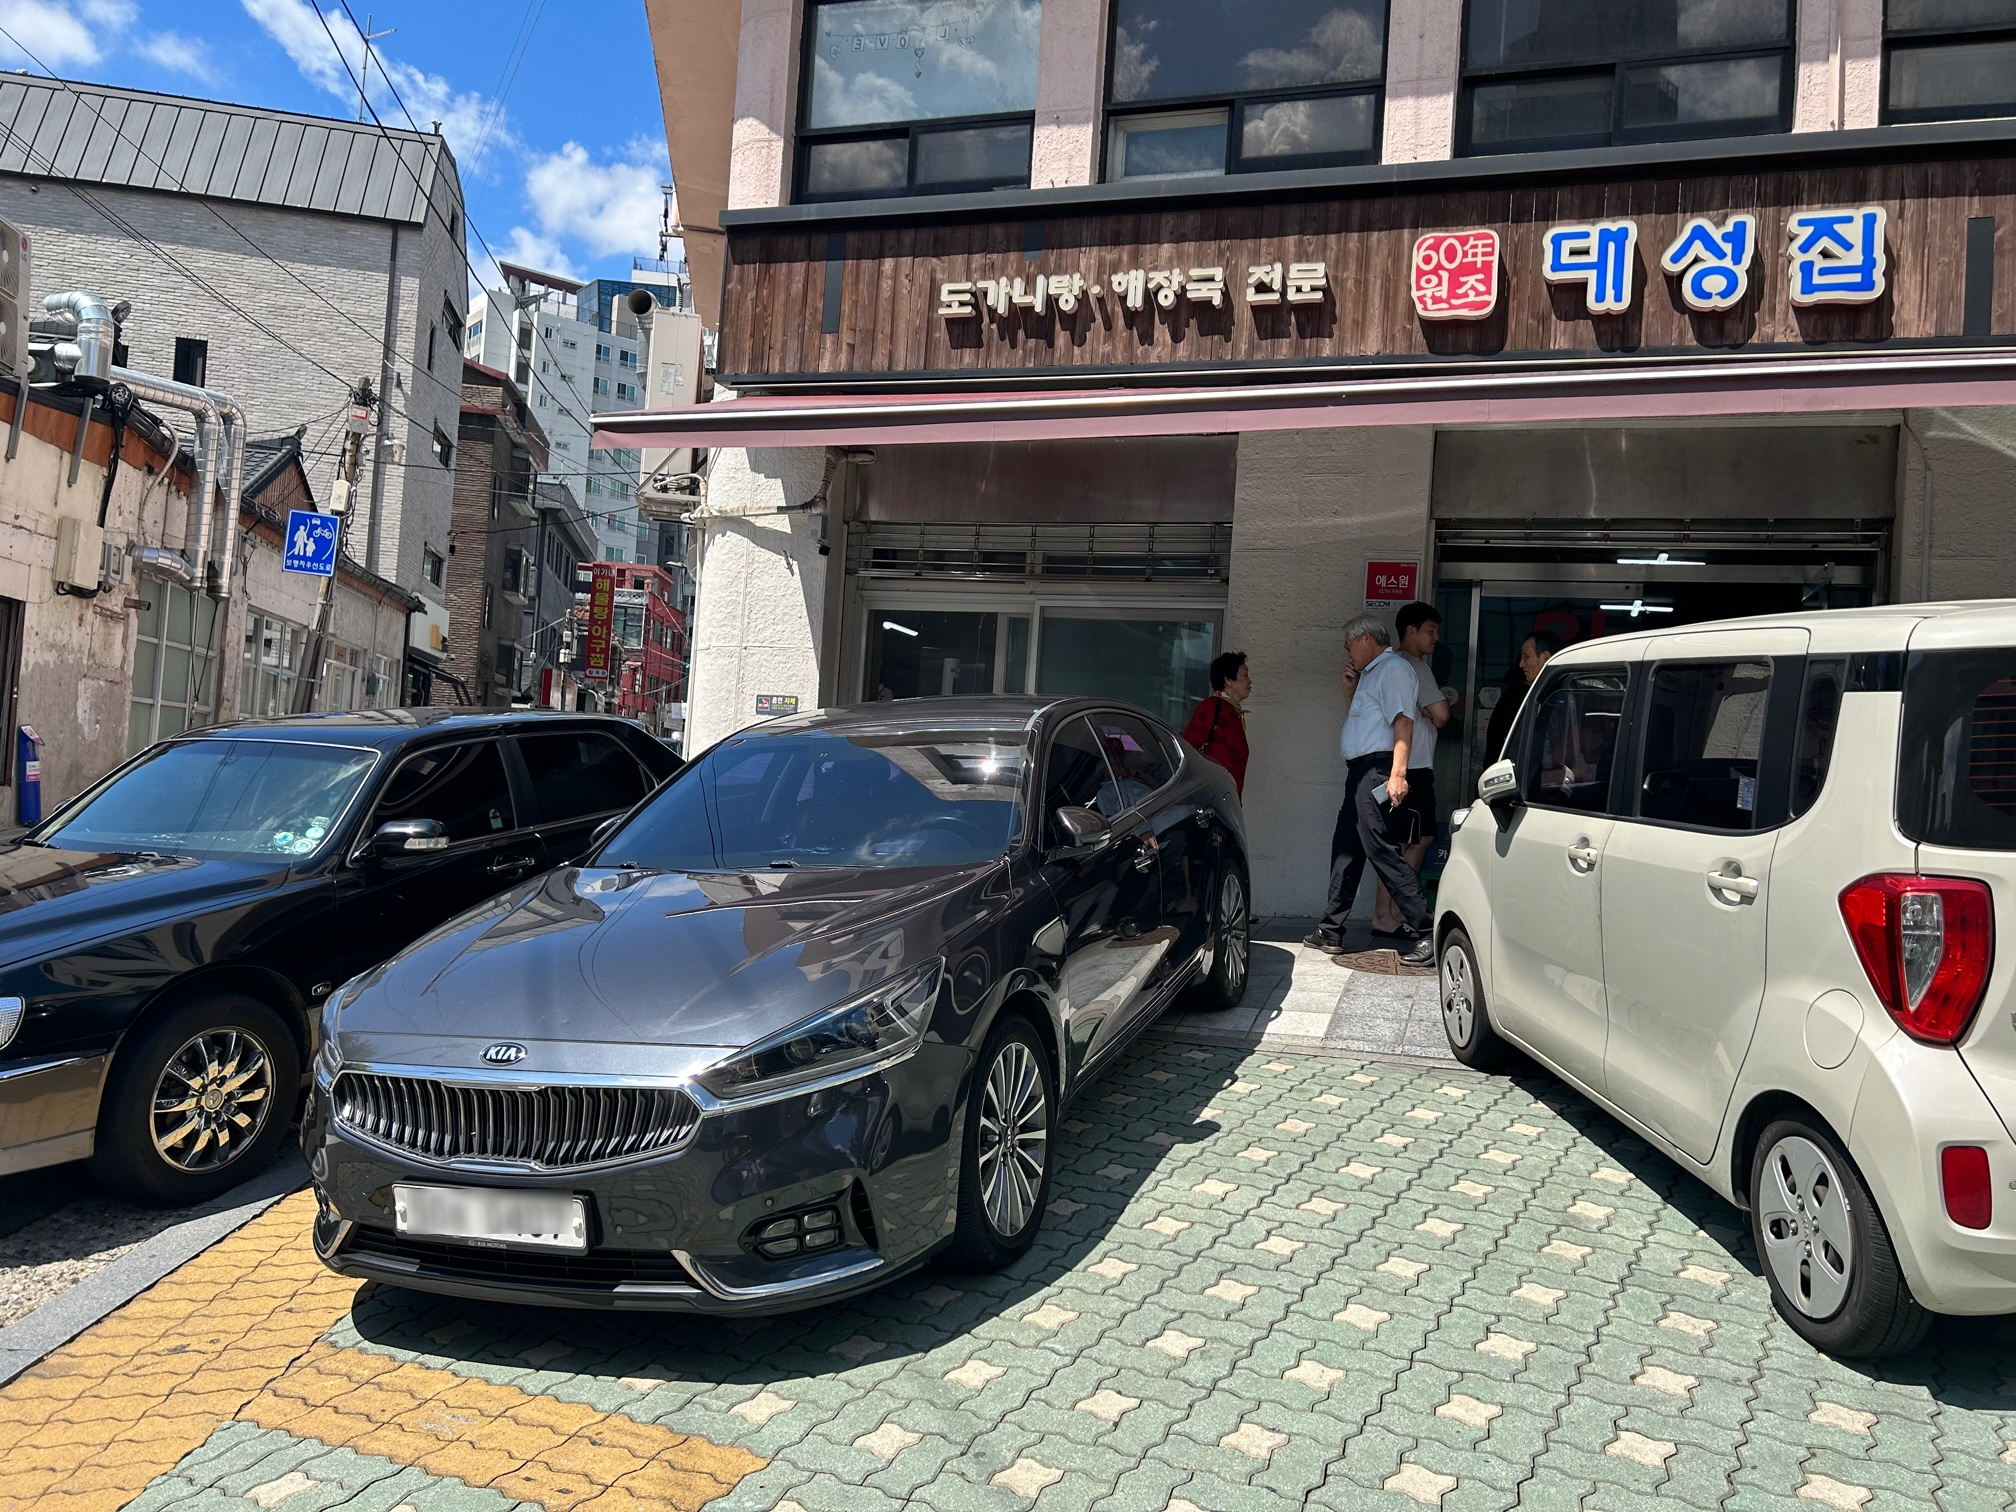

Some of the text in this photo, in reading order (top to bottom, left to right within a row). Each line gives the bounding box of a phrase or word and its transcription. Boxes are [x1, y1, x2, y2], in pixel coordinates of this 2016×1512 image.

[1415, 235, 1495, 271] 60年
[1550, 210, 1879, 305] 대성집
[1246, 261, 1328, 305] 전문
[1416, 270, 1492, 311] 원조
[286, 559, 331, 571] 보행자우선도로
[1375, 574, 1409, 588] 에스원
[486, 1046, 517, 1060] KIA
